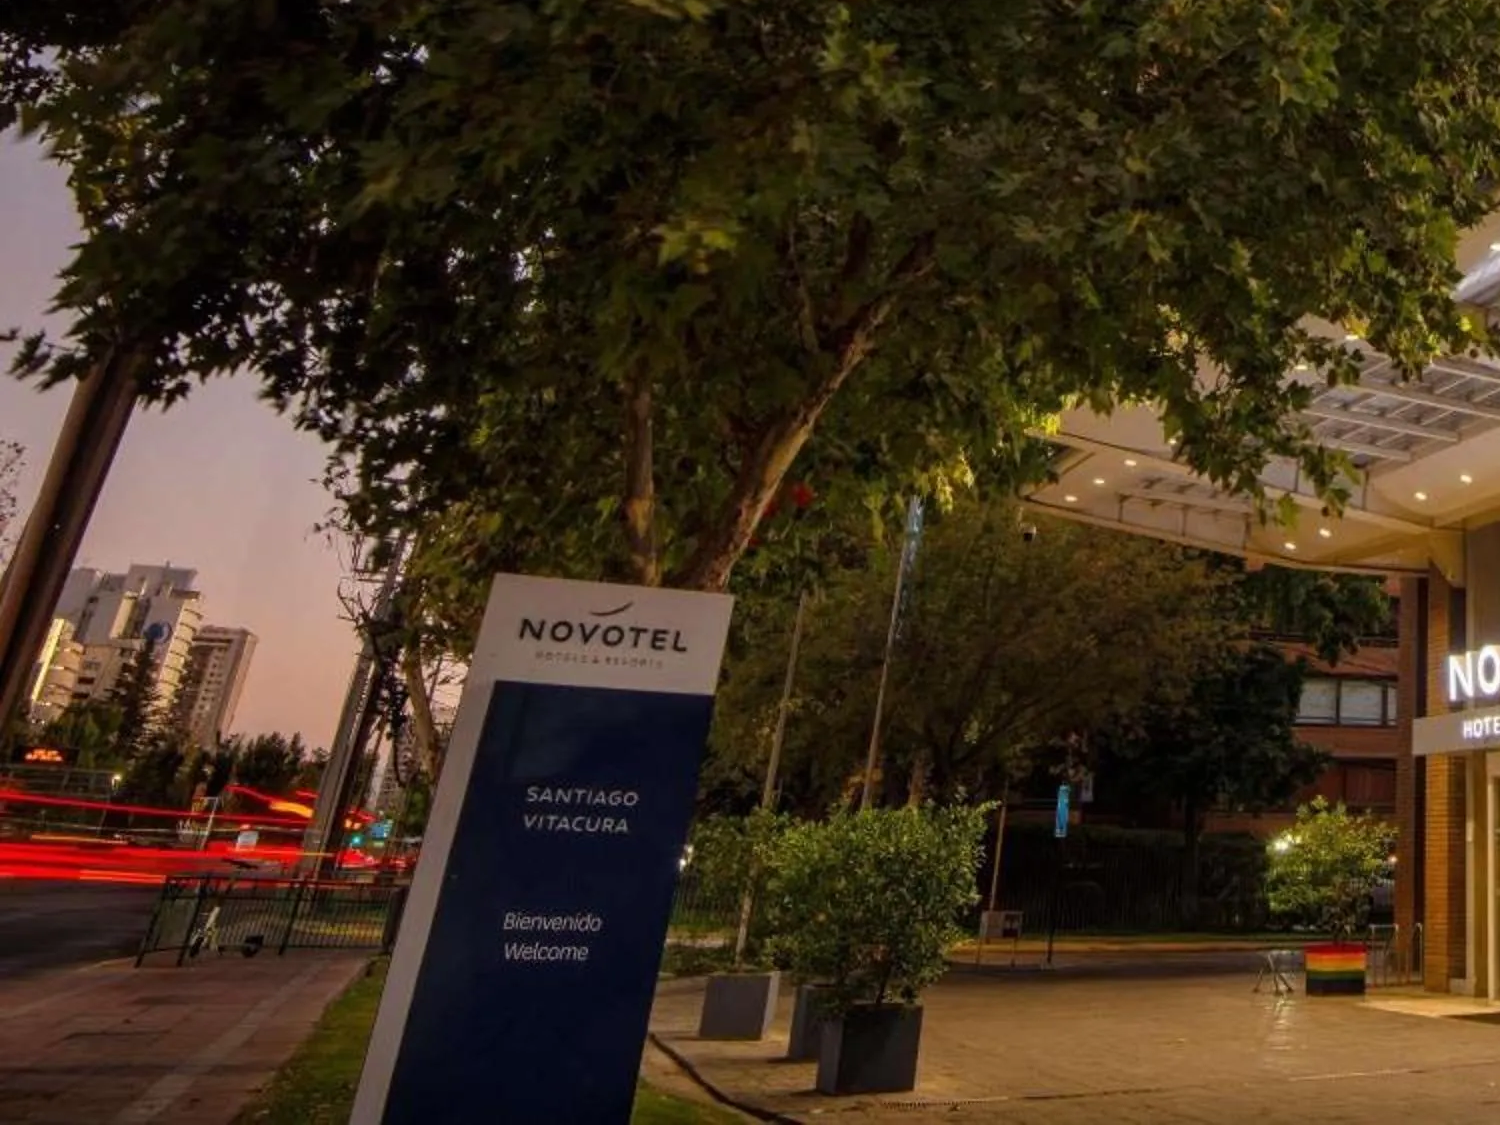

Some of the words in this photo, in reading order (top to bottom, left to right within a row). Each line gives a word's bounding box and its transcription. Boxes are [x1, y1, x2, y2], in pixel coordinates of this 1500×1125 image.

[518, 618, 688, 653] NOVOTEL
[526, 786, 640, 806] SANTIAGO
[523, 813, 630, 833] VITACURA
[502, 911, 602, 932] Bienvenido
[503, 941, 589, 961] Welcome
